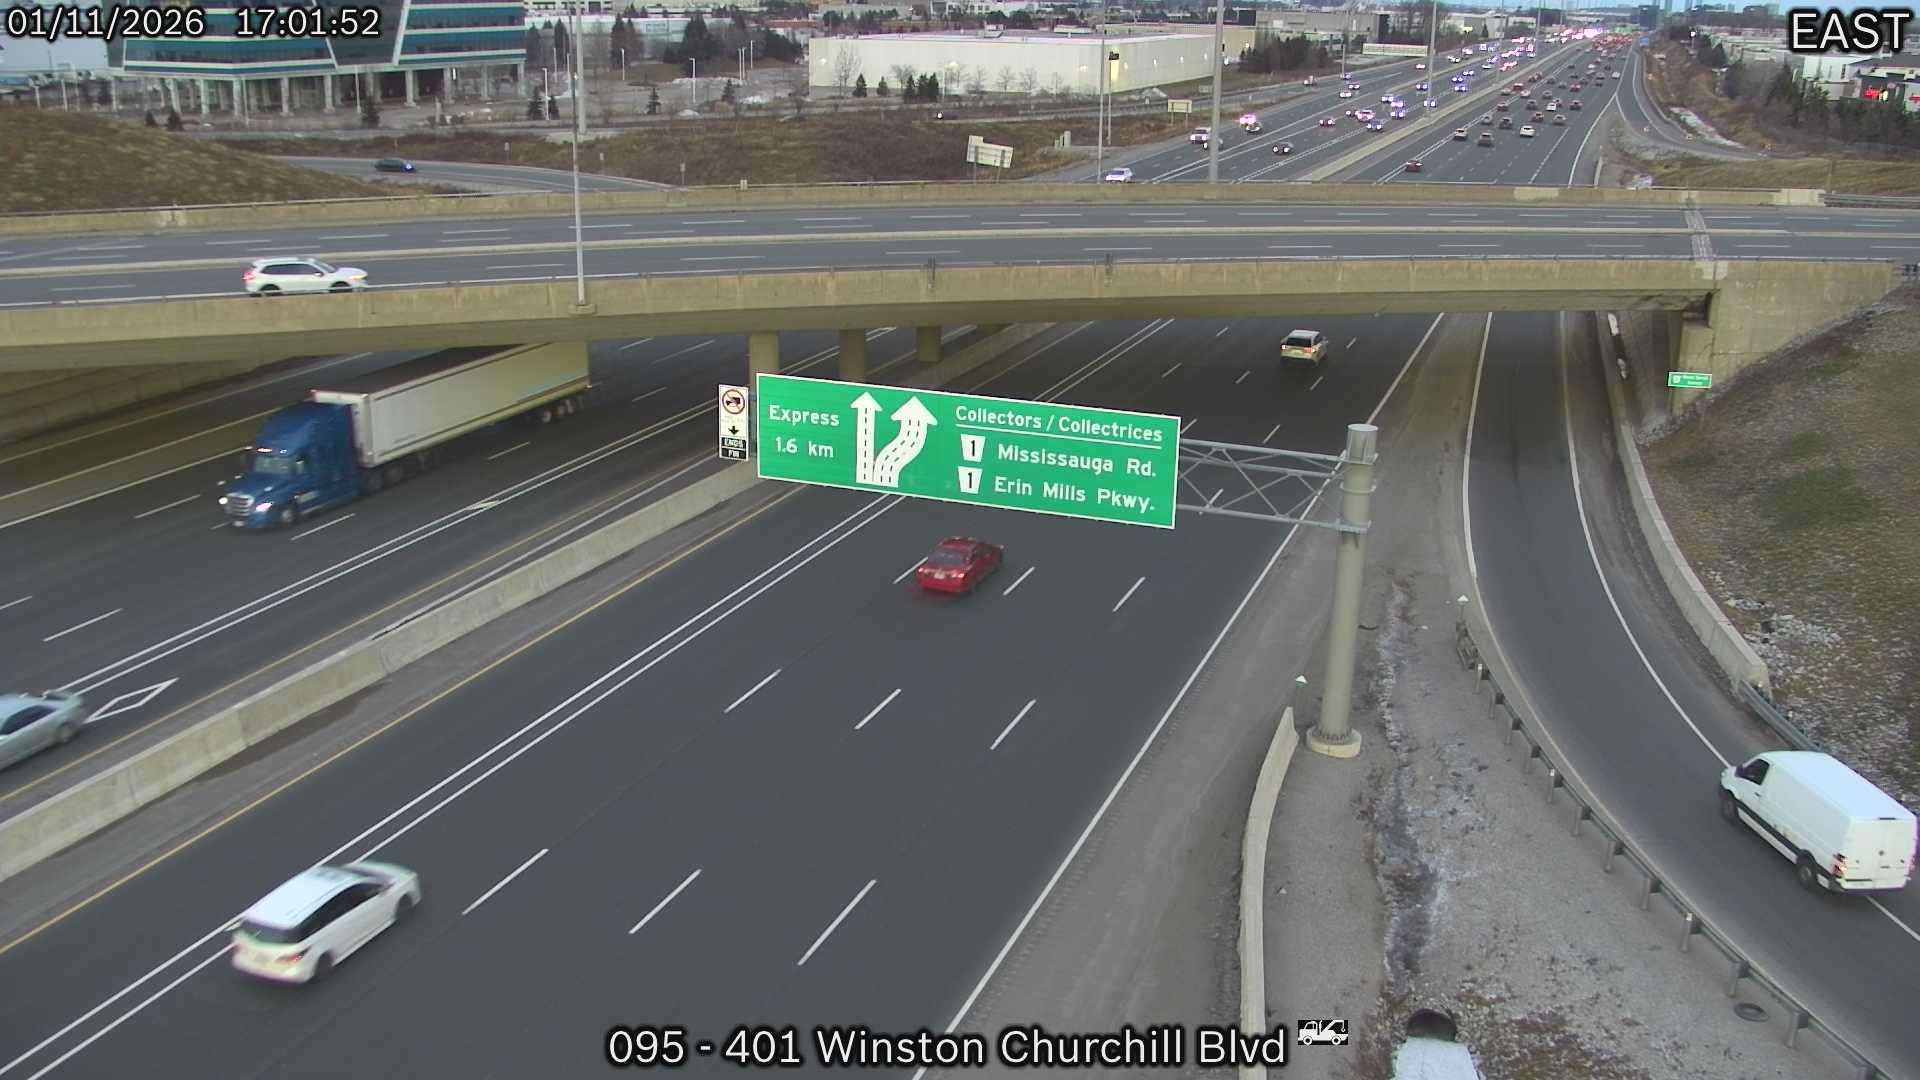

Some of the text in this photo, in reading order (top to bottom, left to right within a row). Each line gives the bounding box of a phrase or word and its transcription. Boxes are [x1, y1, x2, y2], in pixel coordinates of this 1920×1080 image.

[769, 404, 840, 427] Express
[955, 405, 1042, 429] Collectors
[1059, 416, 1163, 442] Collectrices
[775, 436, 834, 459] 1.6 km
[998, 444, 1113, 476] Mississauga
[1126, 458, 1157, 478] Rd.
[994, 476, 1032, 496] Erin
[1043, 482, 1086, 502] Mills
[1097, 488, 1155, 513] Pkwy.
